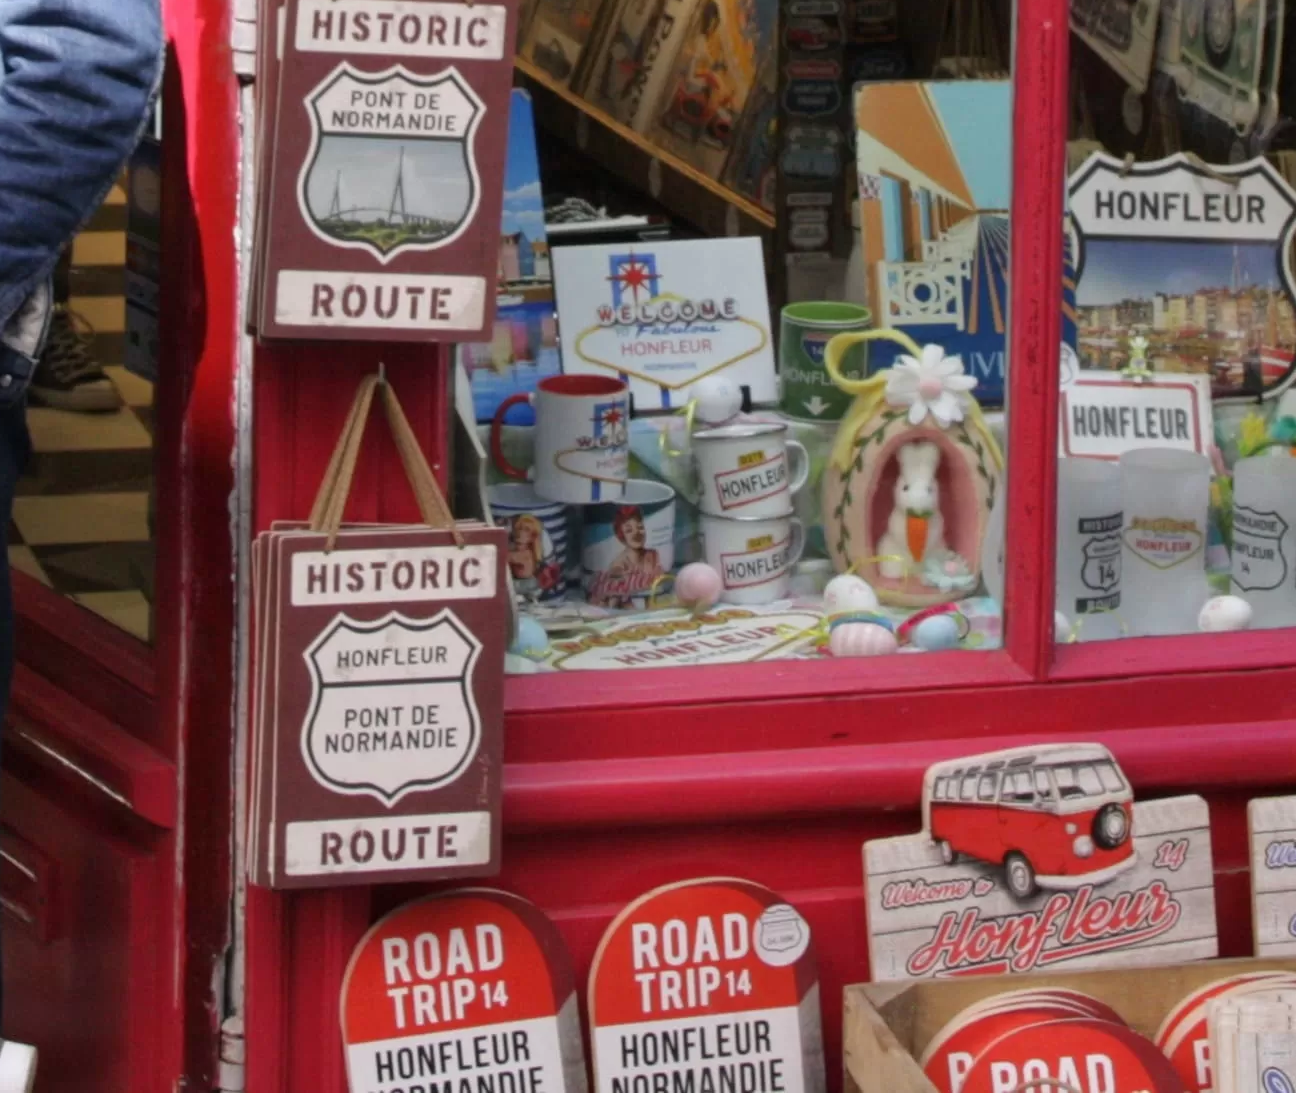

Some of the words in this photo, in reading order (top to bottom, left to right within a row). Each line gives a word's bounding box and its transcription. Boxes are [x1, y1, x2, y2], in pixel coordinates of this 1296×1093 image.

[312, 10, 491, 48] HISTORIC
[350, 90, 409, 109] PONT
[413, 92, 441, 110] DE
[331, 111, 458, 132] NORMANDIE
[1095, 191, 1266, 225] HONFLEUR
[311, 283, 454, 322] ROUTE
[597, 298, 737, 327] WELCOME
[620, 338, 713, 357] HONFLEUR
[1073, 403, 1191, 442] HONFLEUR
[721, 464, 786, 499] HONFLEUR
[306, 557, 483, 595] HISTORIC
[336, 645, 448, 669] HONFLEUR
[614, 625, 778, 667] HONFLEUR
[344, 706, 405, 729] PONT
[411, 705, 440, 725] DE
[324, 728, 458, 753] NORMANDIE
[320, 825, 458, 866] ROUTE
[1154, 839, 1188, 870] 14
[881, 878, 972, 909] Welcome
[973, 876, 995, 895] to
[632, 912, 750, 970] ROAD
[906, 880, 1181, 973] Honfleur
[382, 923, 504, 985] ROAD
[387, 978, 478, 1029] TRIP
[480, 980, 510, 1008] 14
[635, 964, 722, 1013] TRIP
[726, 969, 753, 996] 14
[375, 1029, 531, 1084] HONFLEUR
[621, 1019, 772, 1069] HONFLEUR
